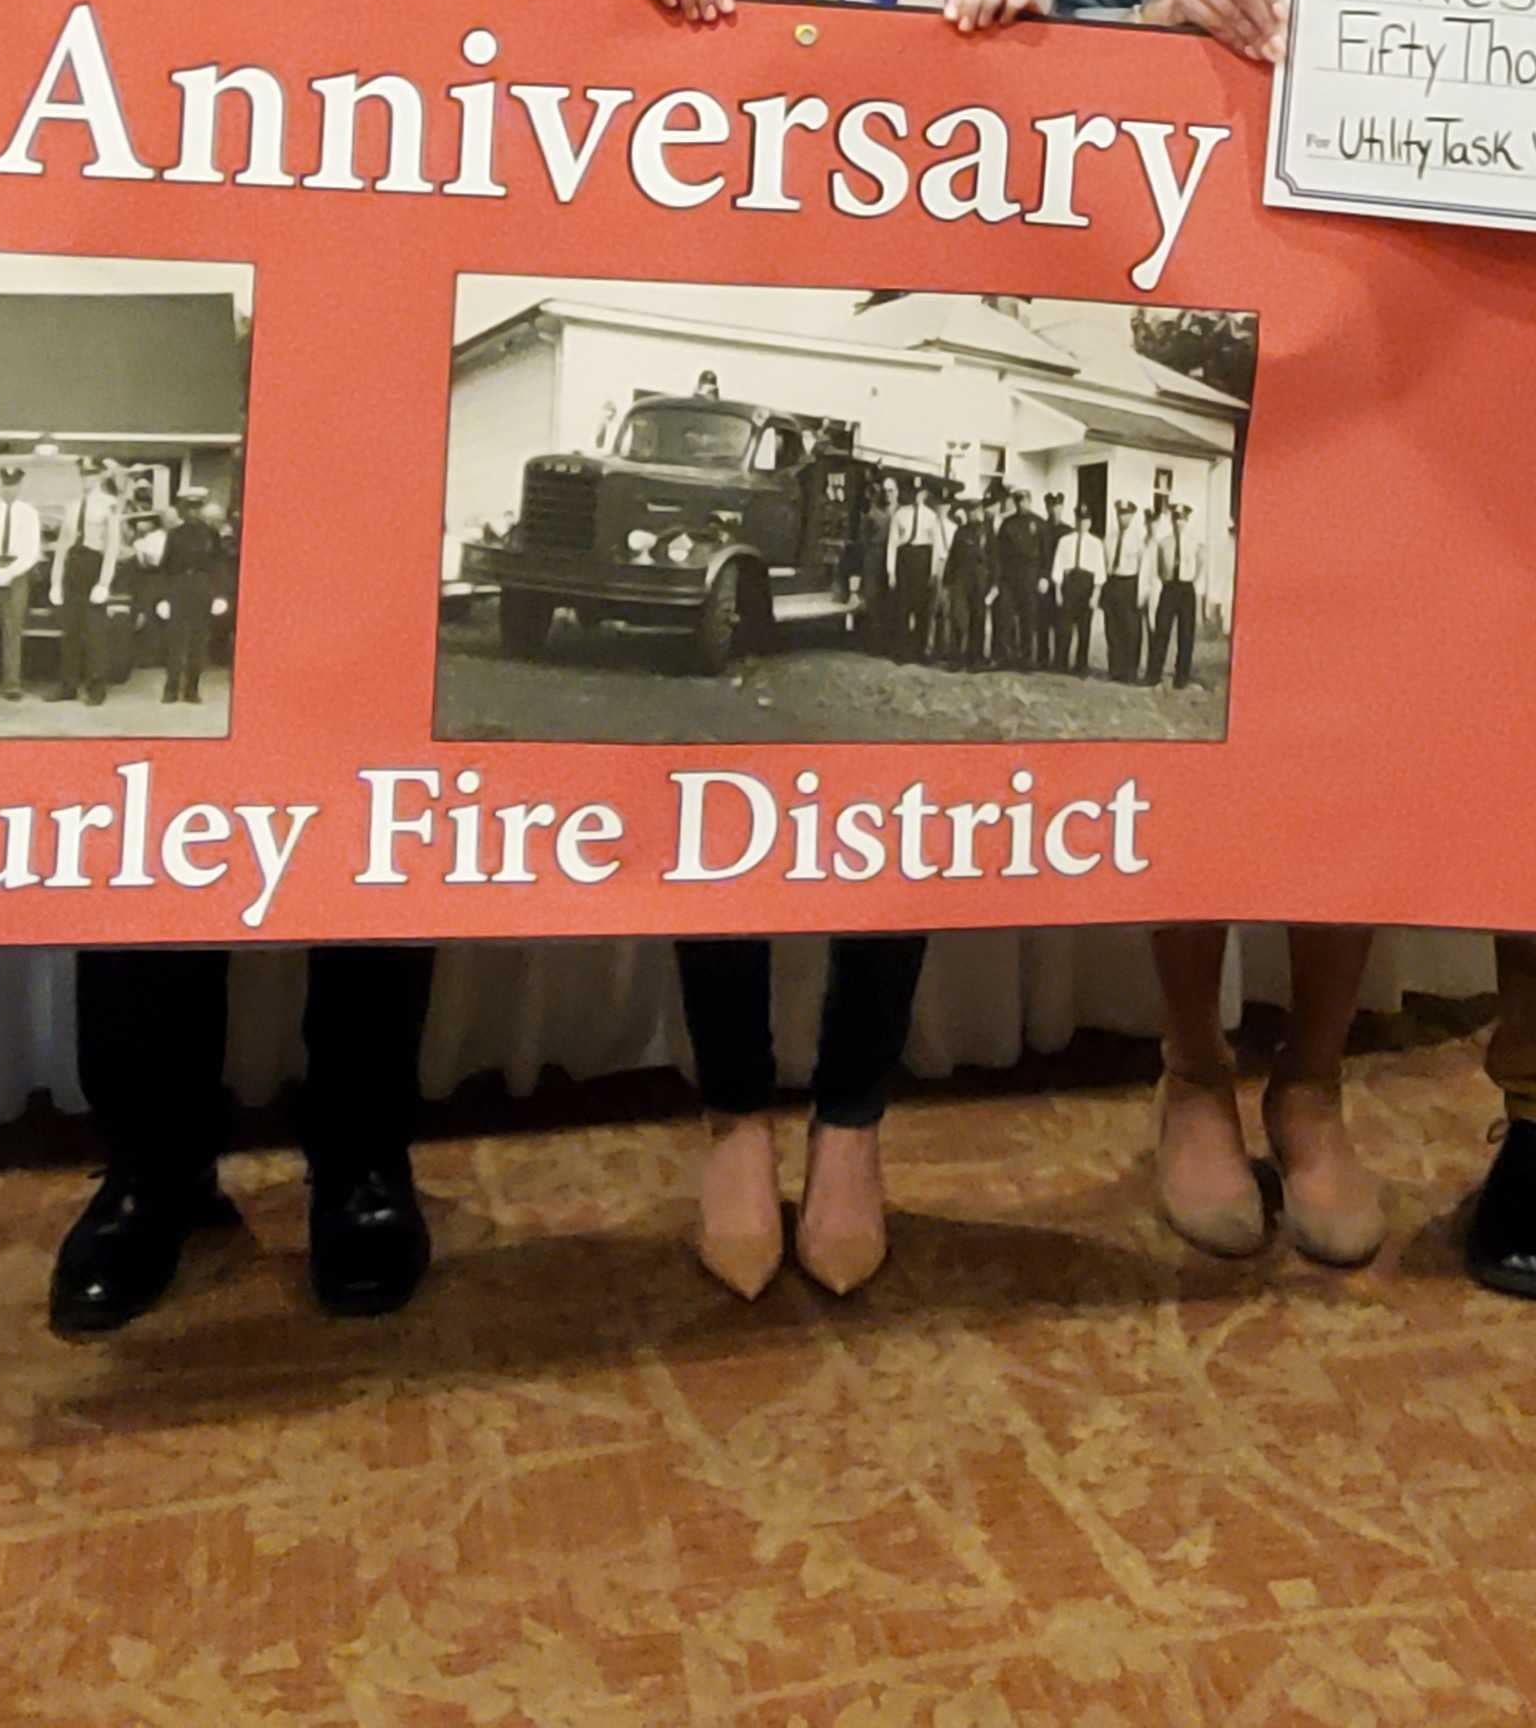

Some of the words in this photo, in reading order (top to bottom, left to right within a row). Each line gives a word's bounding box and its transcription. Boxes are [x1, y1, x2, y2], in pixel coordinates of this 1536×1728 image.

[1338, 10, 1447, 98] Fifty
[1338, 116, 1432, 180] Utility
[353, 767, 624, 885] Fire
[661, 769, 1152, 882] District
